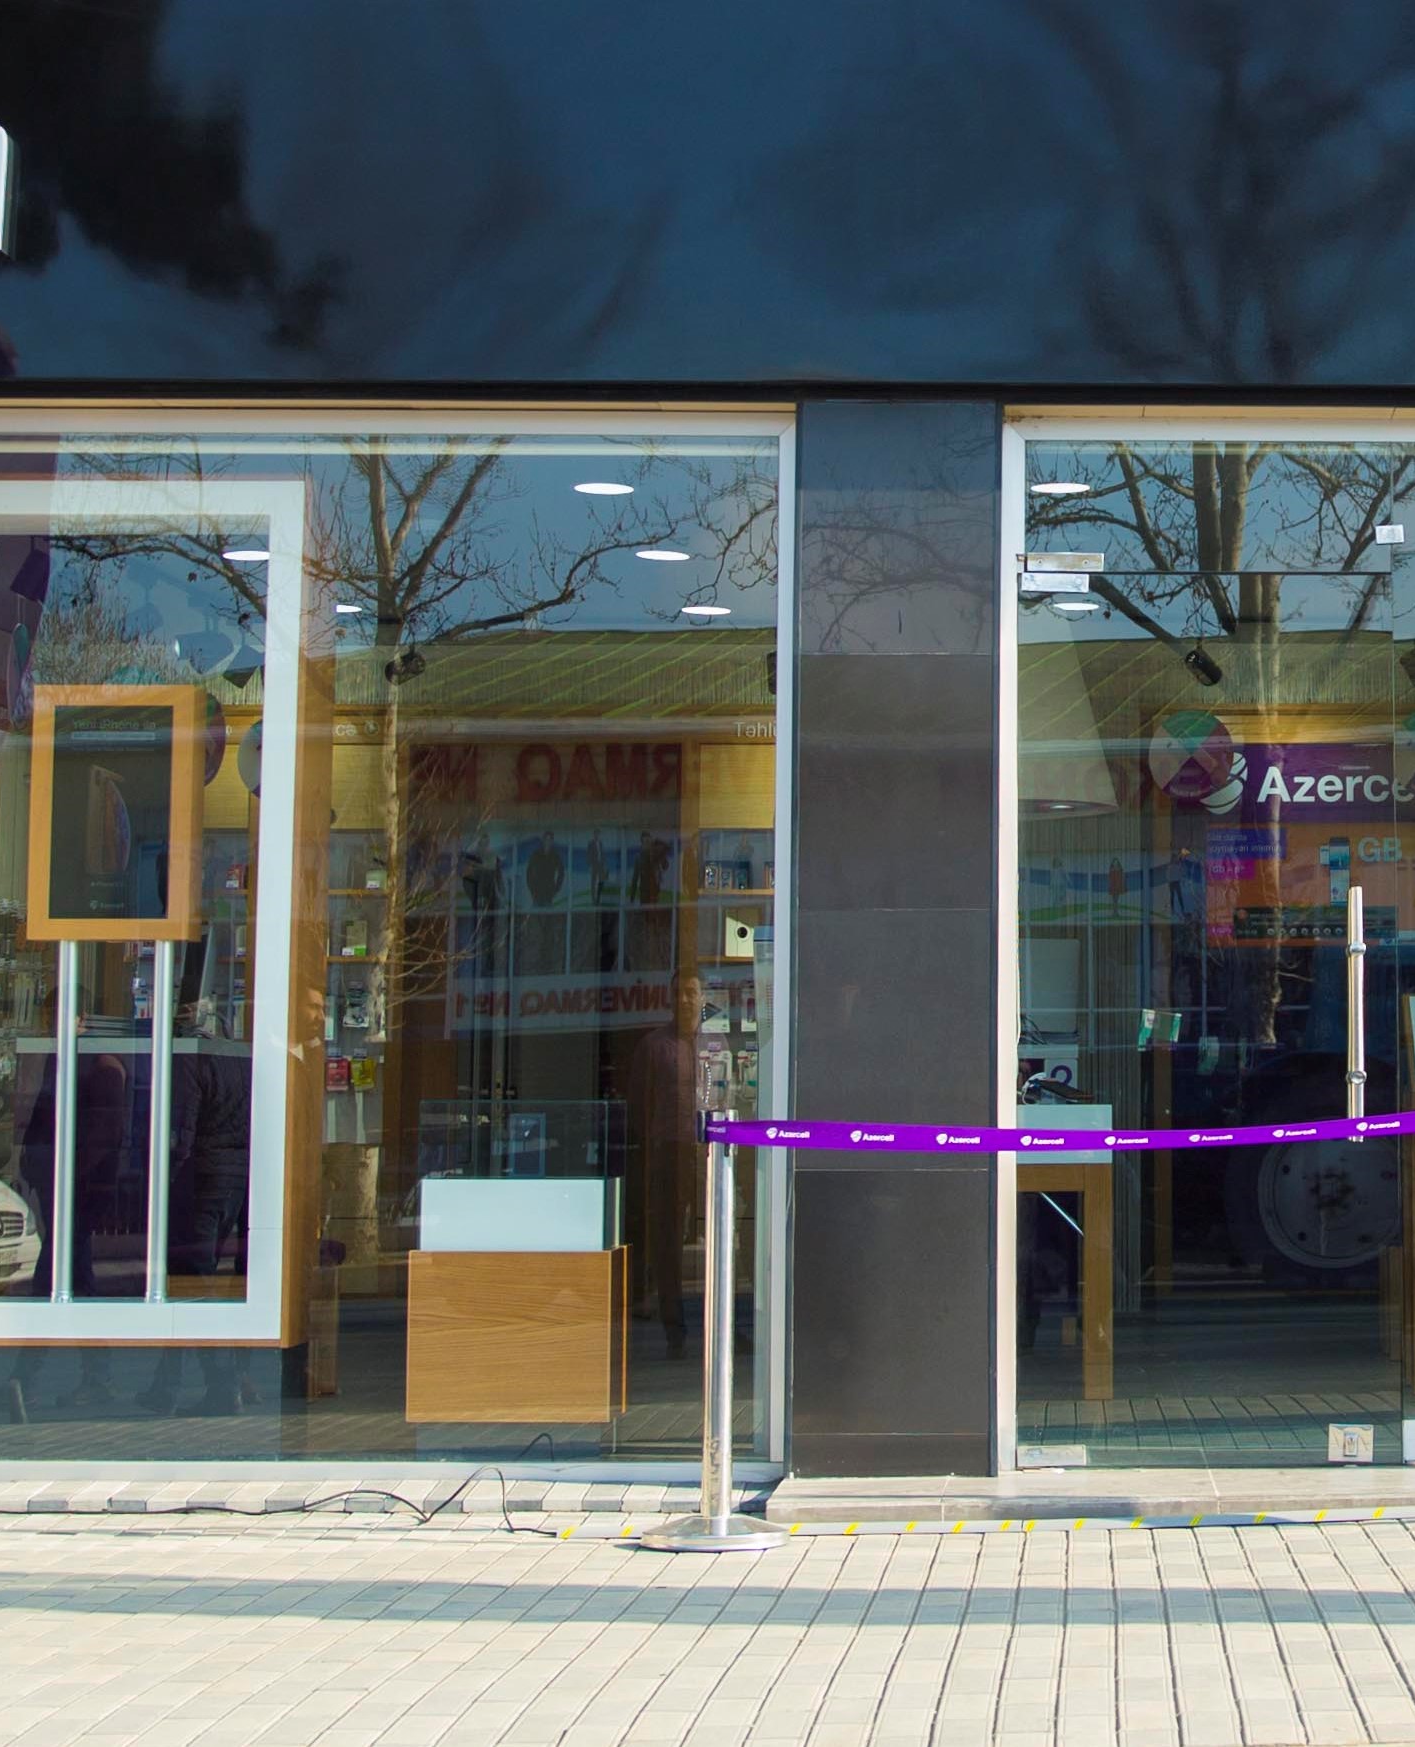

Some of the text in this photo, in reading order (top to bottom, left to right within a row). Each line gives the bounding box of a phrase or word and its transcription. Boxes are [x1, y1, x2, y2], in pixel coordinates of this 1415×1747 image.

[1357, 836, 1403, 863] GB
[778, 1129, 810, 1139] Azercell
[862, 1132, 895, 1142] Azercell
[948, 1135, 980, 1144] Azercell
[1033, 1137, 1065, 1145] Azercell
[1285, 1128, 1317, 1137] Azercell
[1369, 1121, 1401, 1131] Azercell
